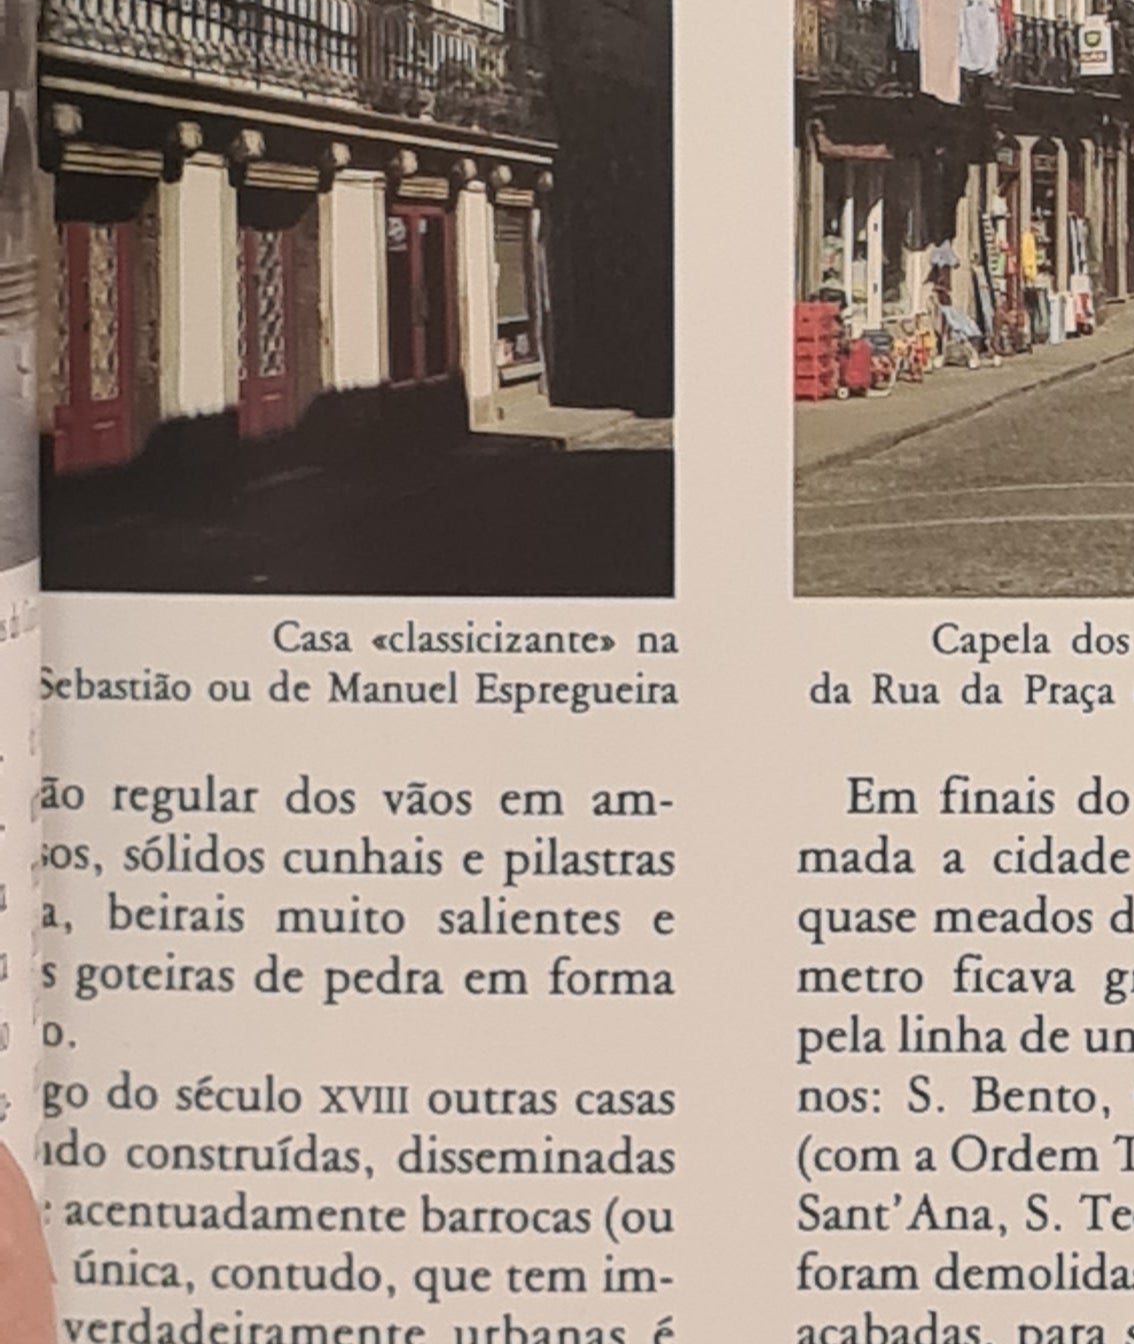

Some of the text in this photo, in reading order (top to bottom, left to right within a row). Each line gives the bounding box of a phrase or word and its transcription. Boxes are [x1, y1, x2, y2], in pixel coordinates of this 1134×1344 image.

[272, 619, 353, 654] Casa
[637, 631, 680, 654] na
[931, 621, 1052, 665] Capela
[1071, 620, 1131, 656] dos
[207, 679, 252, 703] ou
[267, 668, 312, 704] de
[327, 670, 459, 705] Manuel
[474, 671, 680, 715] Espregueira
[809, 670, 853, 705] da
[871, 672, 941, 705] Rua
[960, 670, 1004, 706] da
[1024, 673, 1117, 714] Praça
[112, 773, 260, 825] regular
[285, 773, 356, 816] dos
[381, 781, 473, 817] vãos
[499, 789, 565, 817] em
[591, 789, 674, 817] am-
[846, 776, 919, 815] Em
[939, 773, 1056, 816] finais
[1077, 774, 1131, 817] do
[107, 890, 245, 934] beirais
[275, 894, 406, 936] muito
[437, 895, 621, 937] salientes
[652, 909, 676, 936] e
[797, 907, 917, 946] quase
[932, 893, 1094, 935] meados
[74, 951, 235, 1001] goteiras
[253, 952, 305, 994] de
[322, 953, 445, 1006] pedra
[463, 968, 529, 996] em
[548, 954, 676, 997] forma
[796, 965, 924, 994] metro
[952, 952, 1077, 995] ficava
[797, 1086, 881, 1114] nos:
[907, 1073, 945, 1114] S.
[971, 1075, 1111, 1120] Bento,
[125, 1132, 374, 1180] construídas,
[397, 1133, 676, 1176] disseminadas
[797, 1133, 901, 1184] (com
[914, 1146, 938, 1173] a
[950, 1131, 1100, 1173] Ordem
[73, 1247, 674, 1305] única, contudo, que tem im-
[796, 1249, 921, 1291] foram
